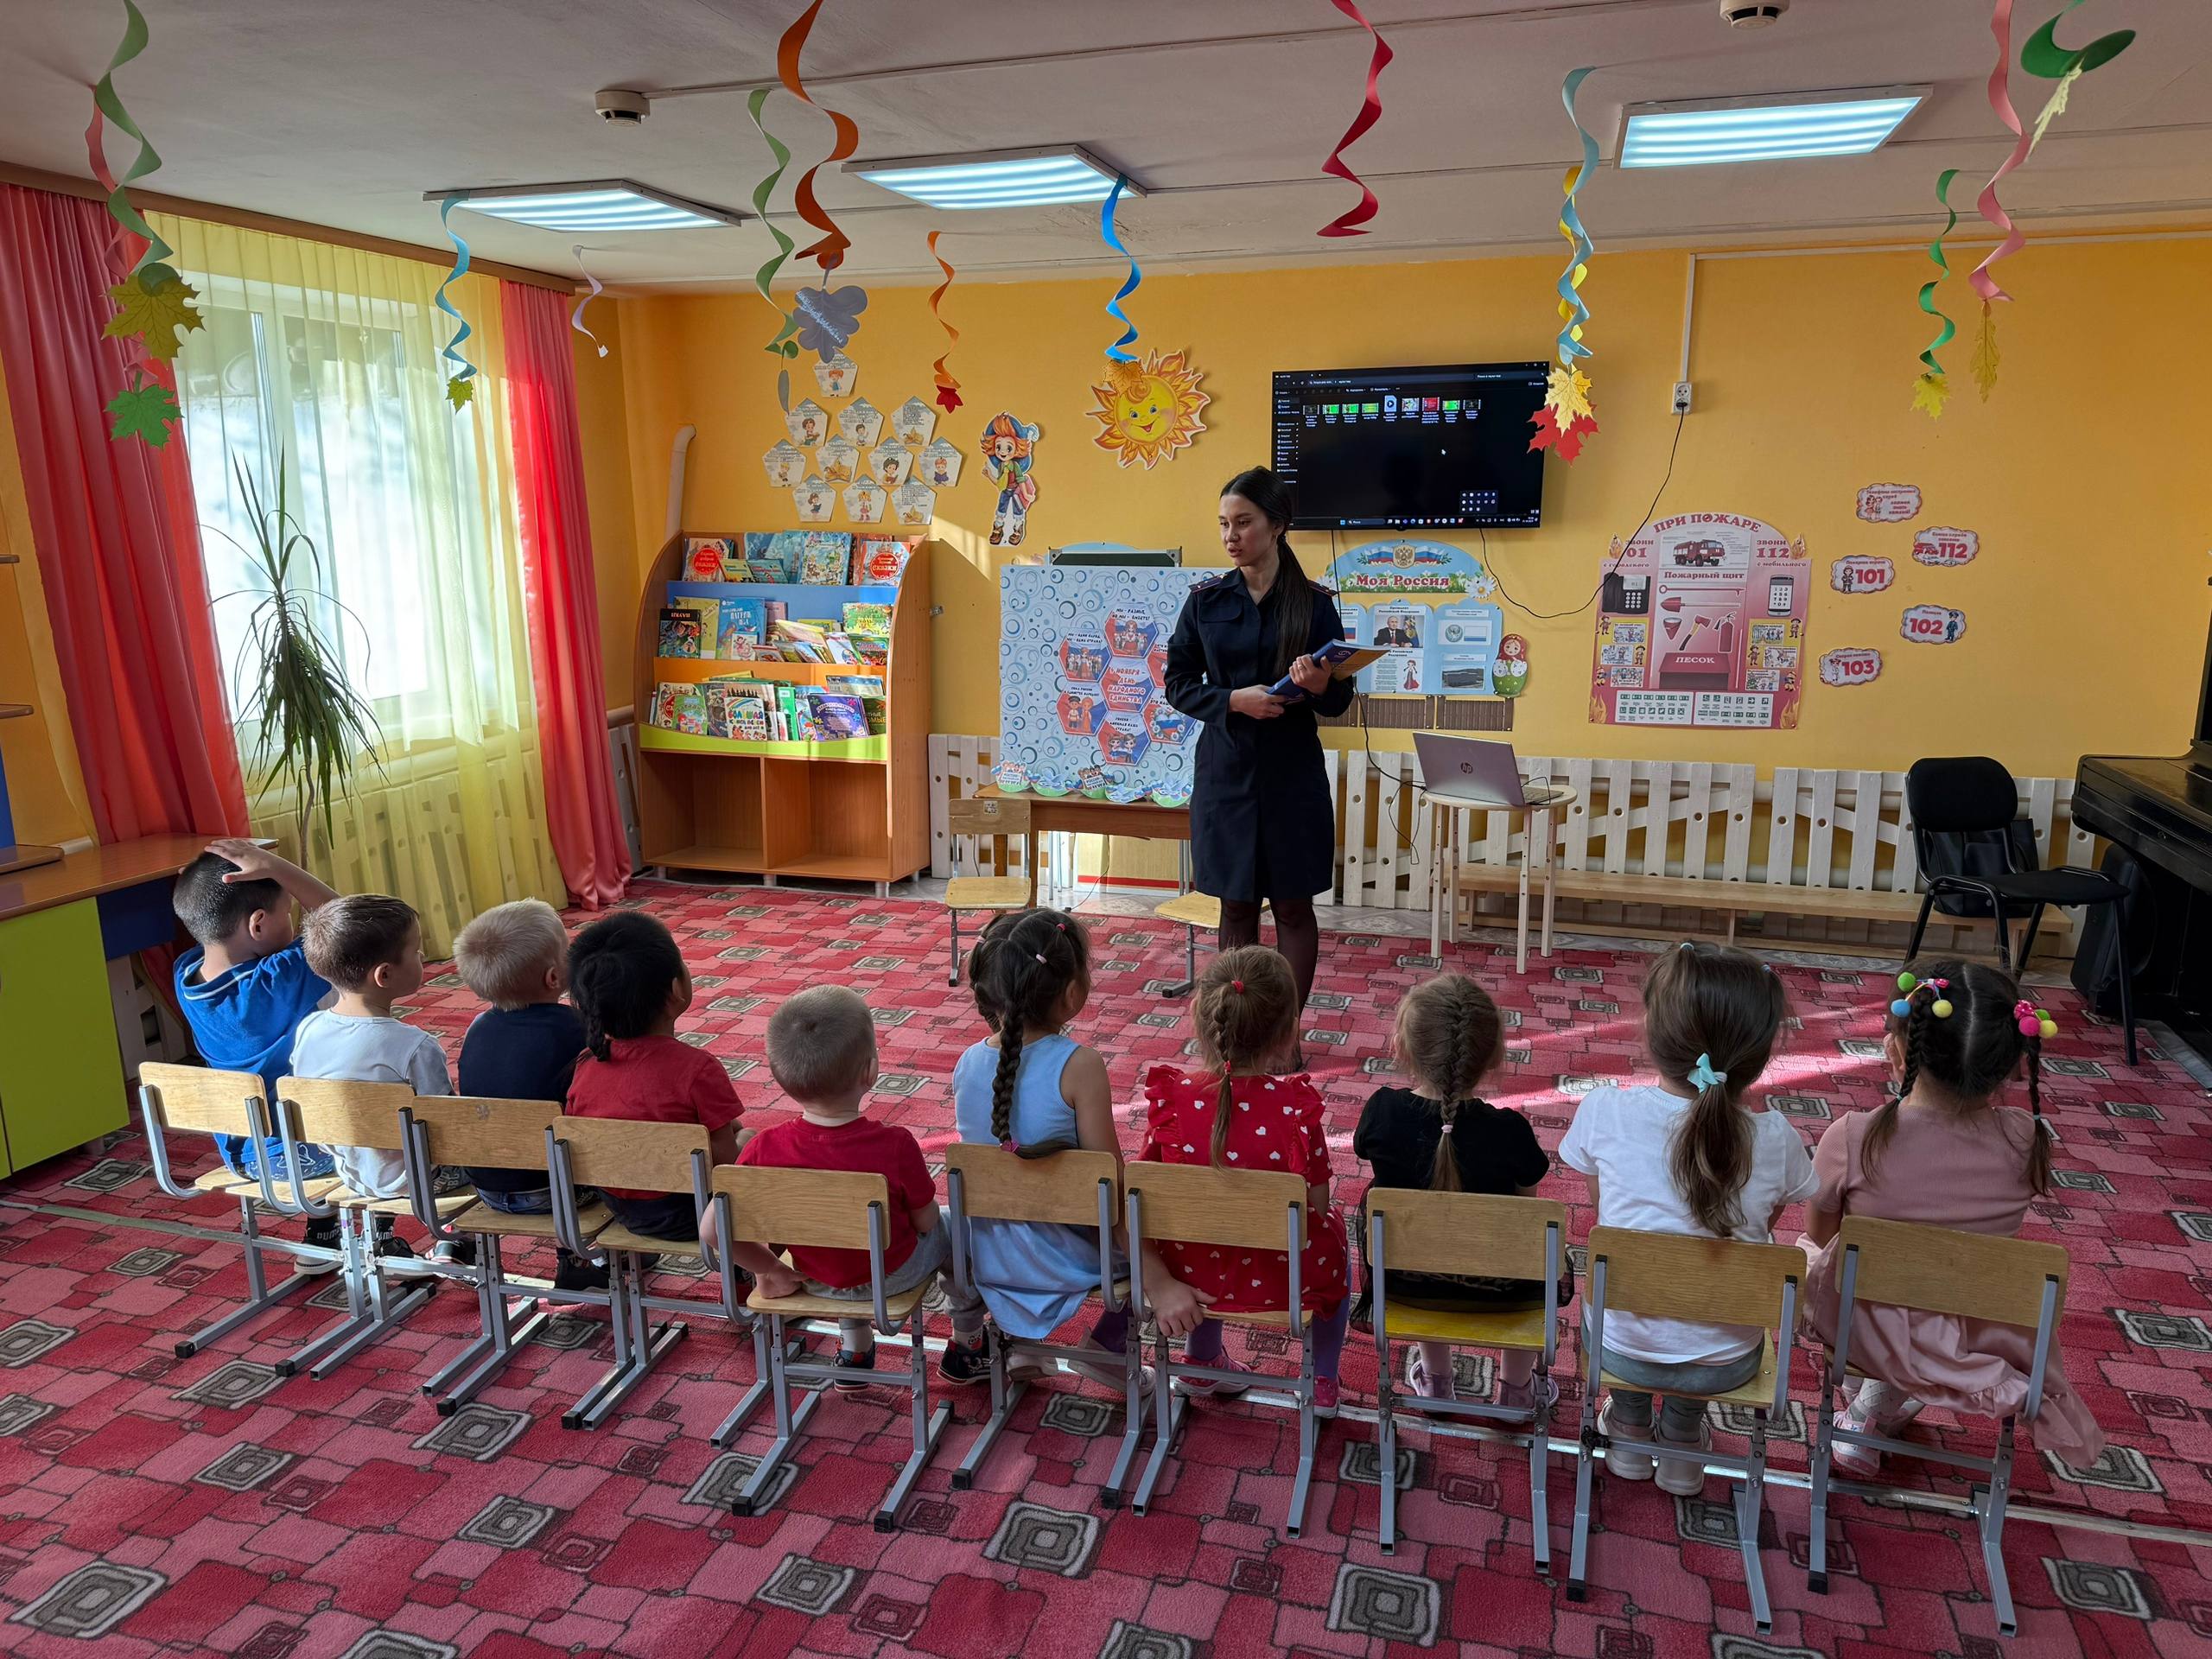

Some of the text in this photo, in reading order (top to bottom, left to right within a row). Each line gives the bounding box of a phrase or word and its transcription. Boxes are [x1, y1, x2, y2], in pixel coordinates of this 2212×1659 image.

[1653, 513, 1762, 533] ПРИ ПОЖАРЕ
[1626, 547, 1647, 558] 01
[1756, 547, 1789, 558] 112
[1939, 542, 1967, 558] 112
[1356, 575, 1449, 586] Моя Россия
[1664, 571, 1720, 579] Пожарный
[1855, 569, 1885, 584] 101
[1910, 618, 1943, 635] 102
[1841, 659, 1875, 676] 103
[1108, 686, 1145, 694] НАРОДНОГО
[1110, 694, 1142, 703] ЕДИНСТВА
[1460, 762, 1473, 774] hp
